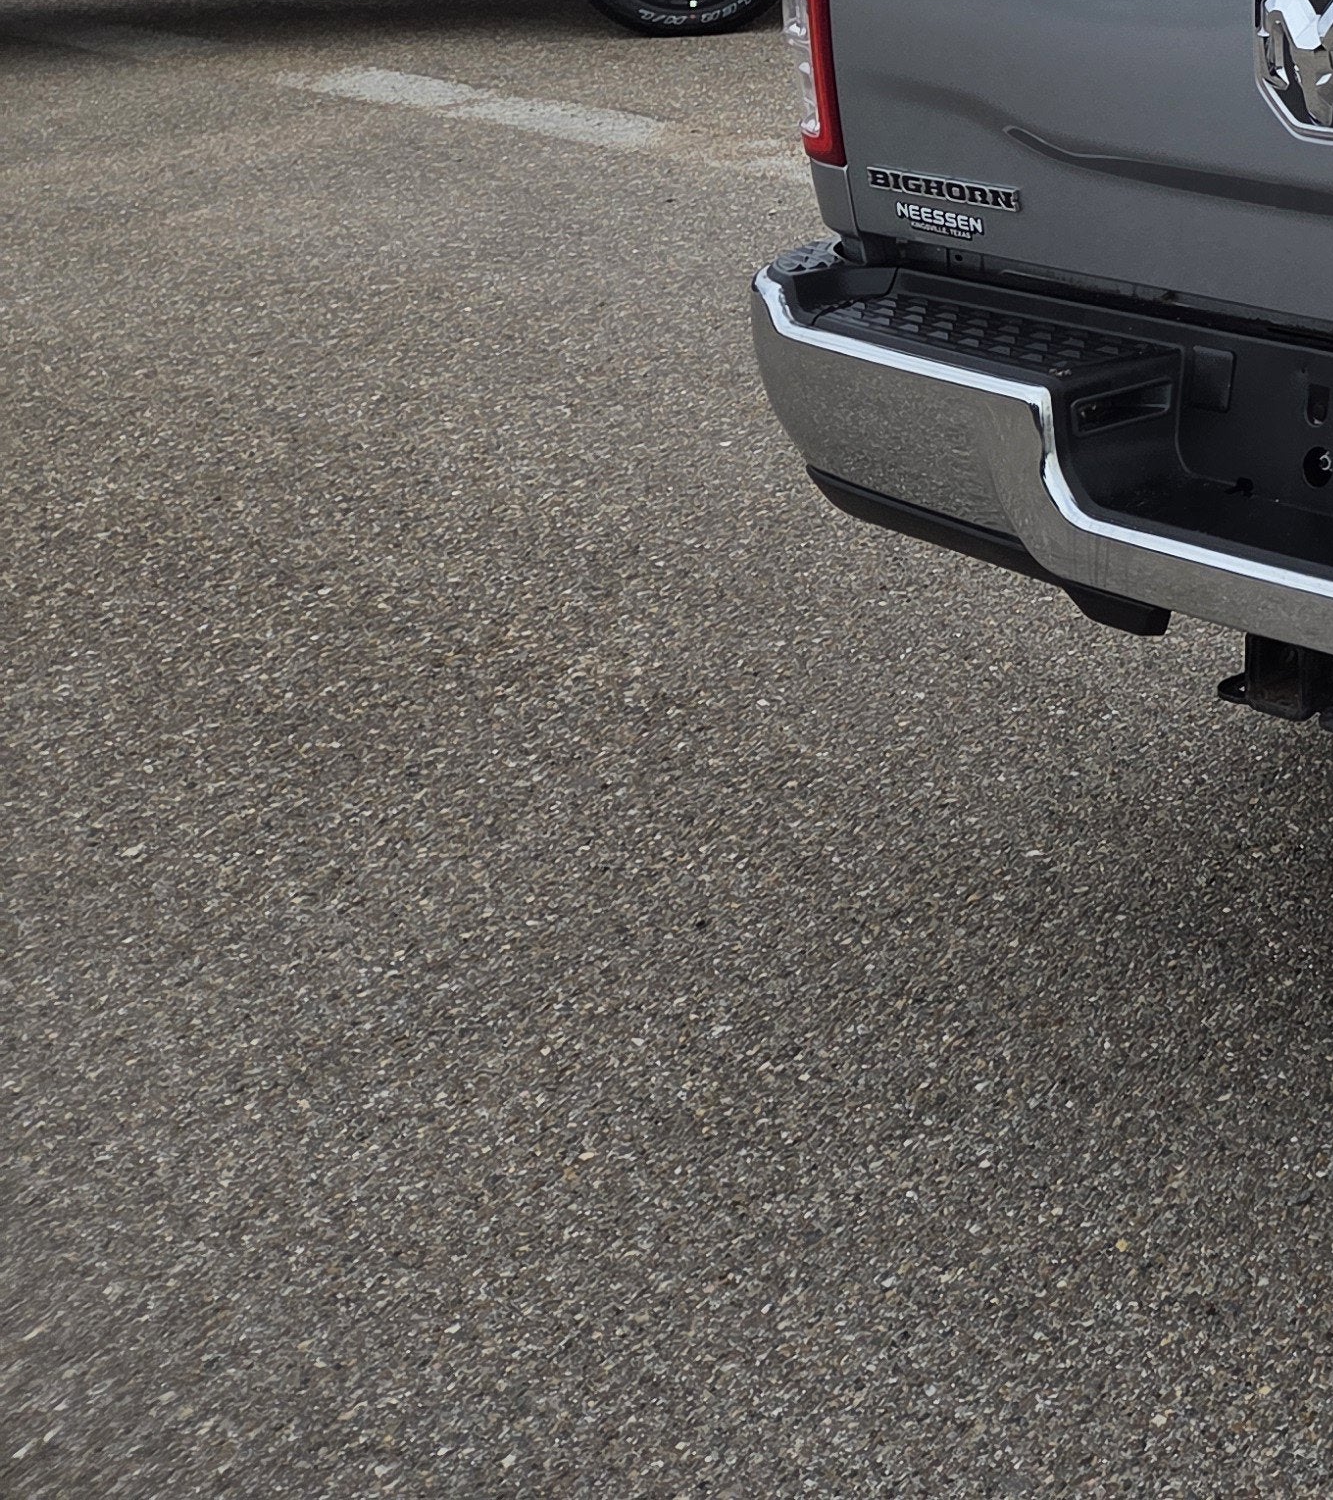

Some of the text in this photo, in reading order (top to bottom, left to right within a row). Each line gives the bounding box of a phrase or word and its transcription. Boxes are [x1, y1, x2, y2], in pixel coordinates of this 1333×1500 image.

[867, 166, 1021, 212] BIGHORN
[896, 201, 983, 234] NEESSEN
[950, 228, 971, 239] TEXAS
